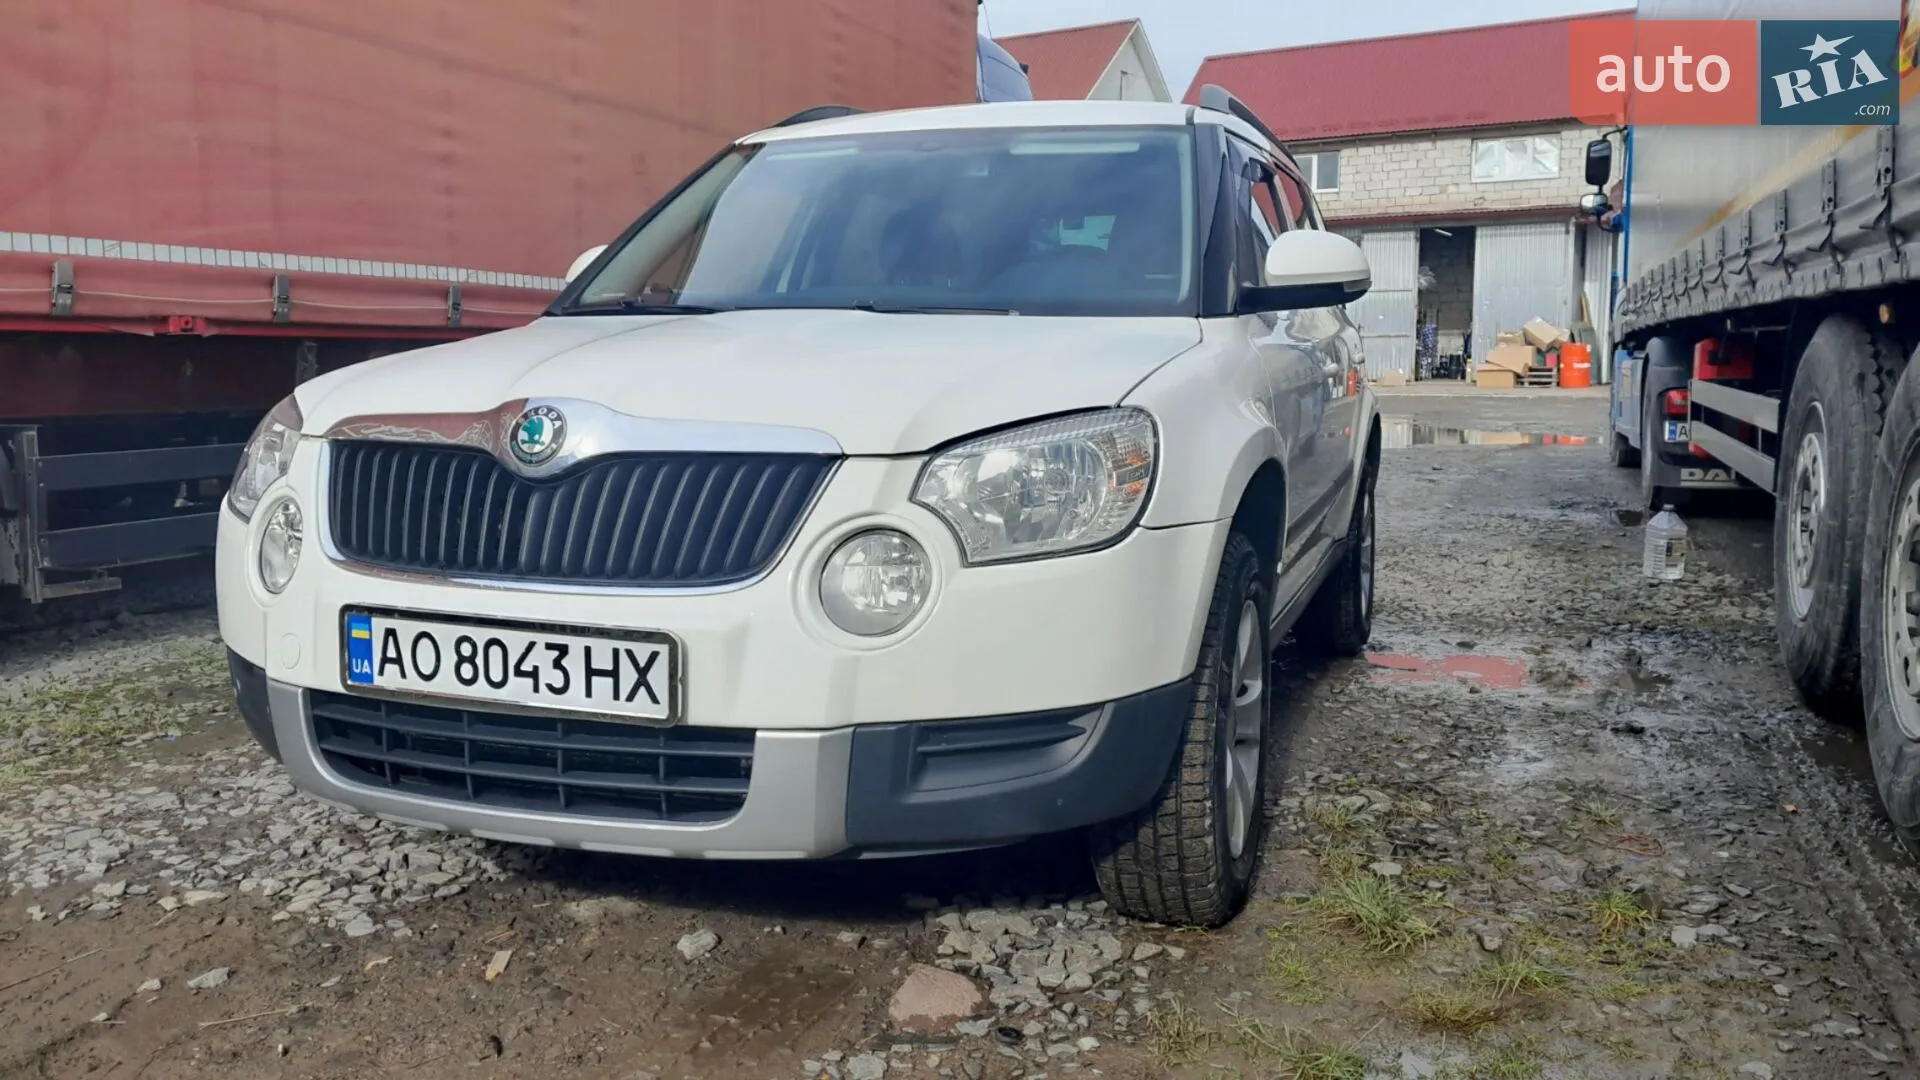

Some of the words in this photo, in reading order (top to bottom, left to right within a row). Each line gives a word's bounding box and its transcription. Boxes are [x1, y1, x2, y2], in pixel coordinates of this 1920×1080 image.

[352, 657, 372, 675] UA
[377, 627, 442, 682] AO
[453, 635, 571, 696] 8043
[584, 645, 662, 705] HX
